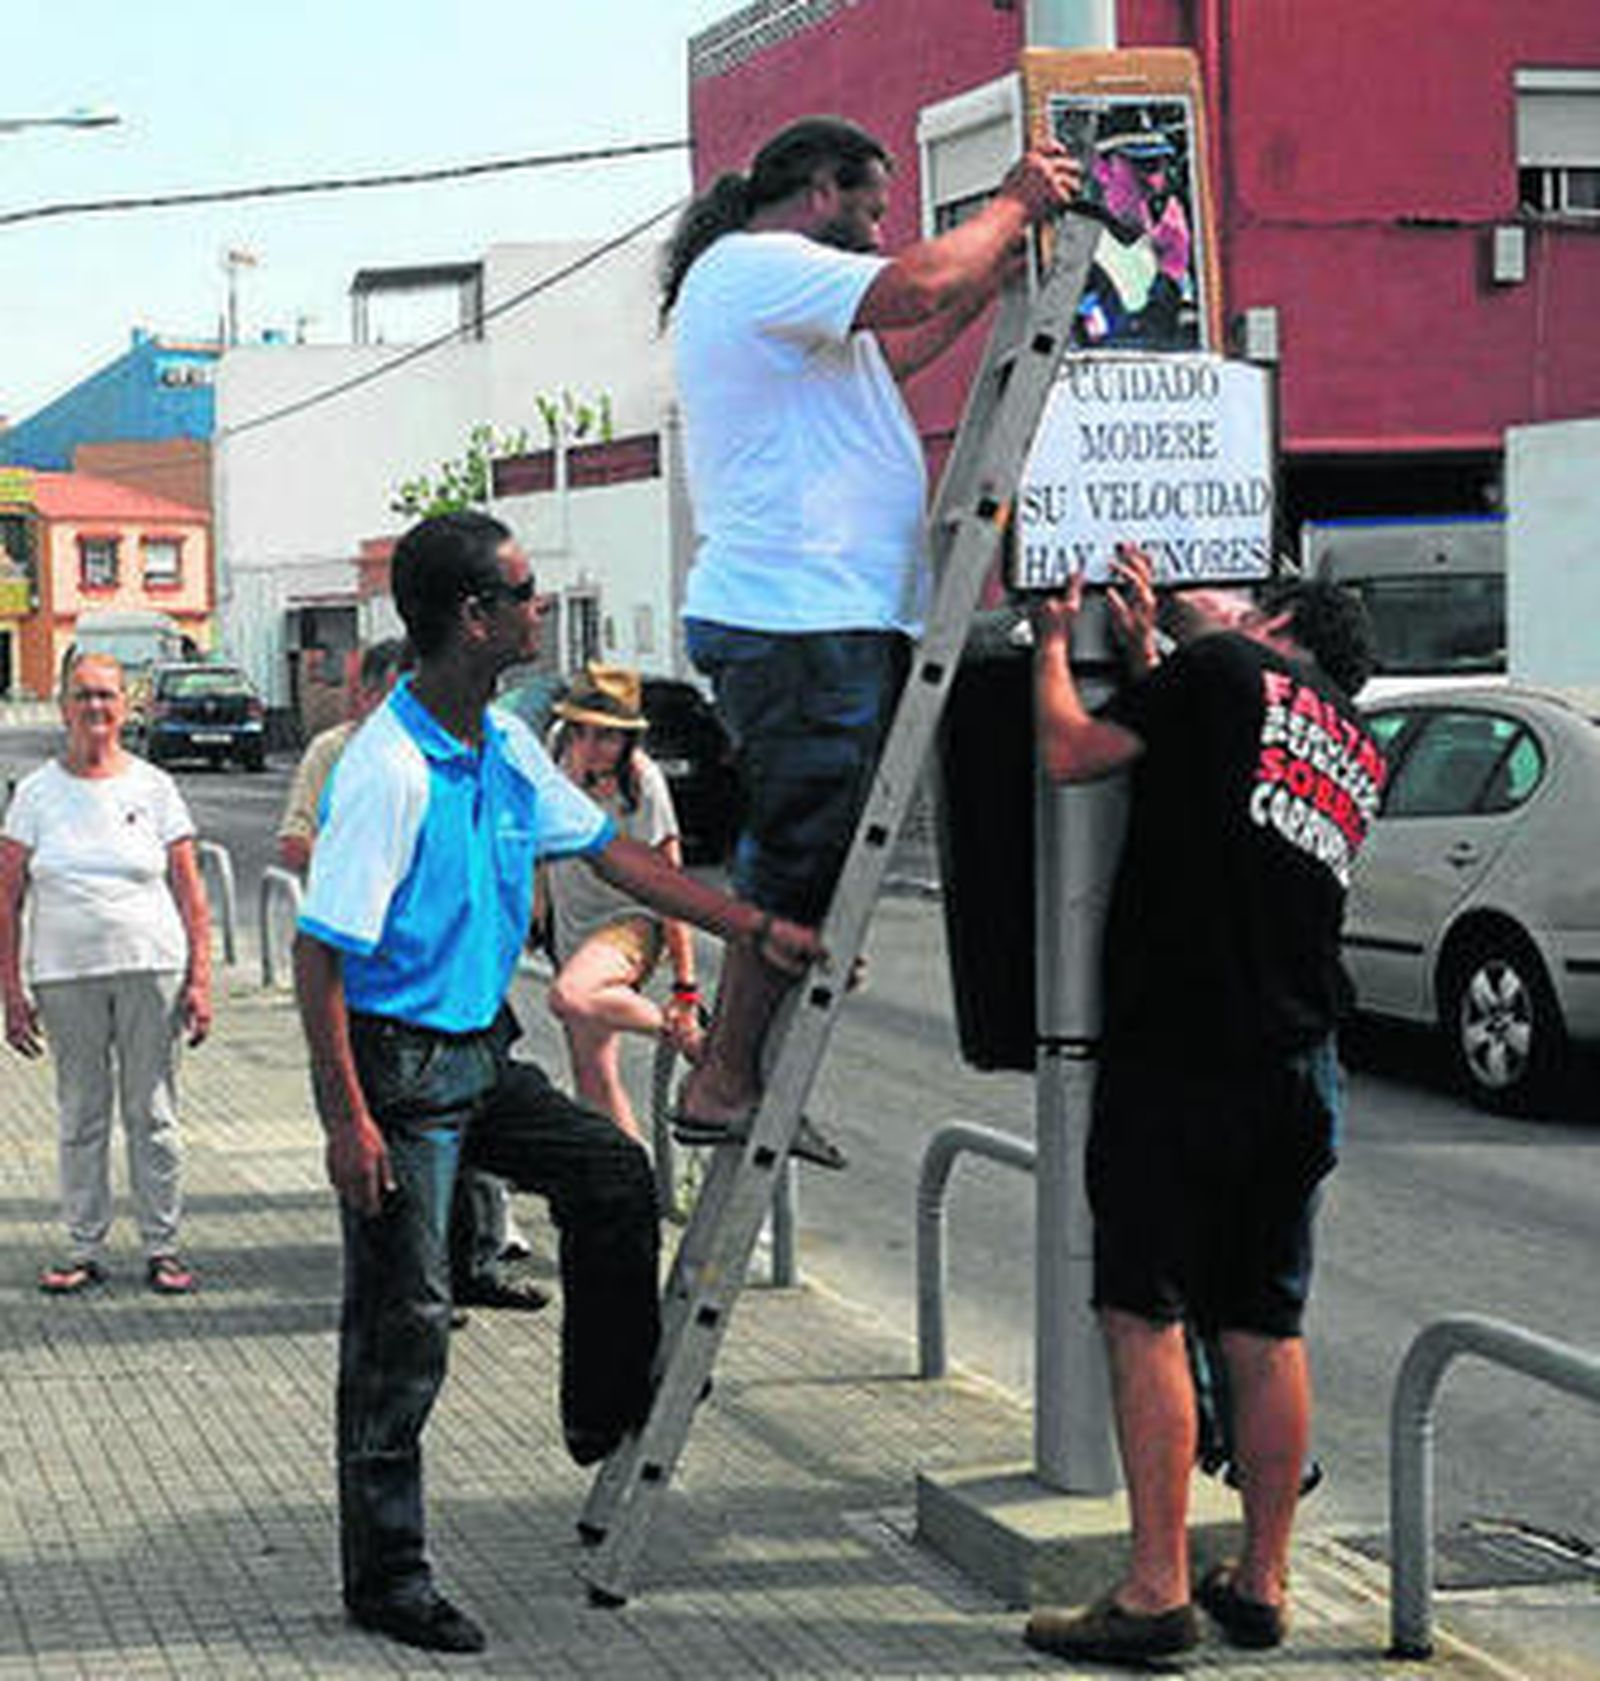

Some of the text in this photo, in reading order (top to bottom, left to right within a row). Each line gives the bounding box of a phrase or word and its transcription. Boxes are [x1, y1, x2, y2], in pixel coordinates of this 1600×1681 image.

[1068, 362, 1220, 403] CUIDADO
[1078, 420, 1218, 463] MODERE
[1021, 479, 1275, 527] SU VELOCIDAD
